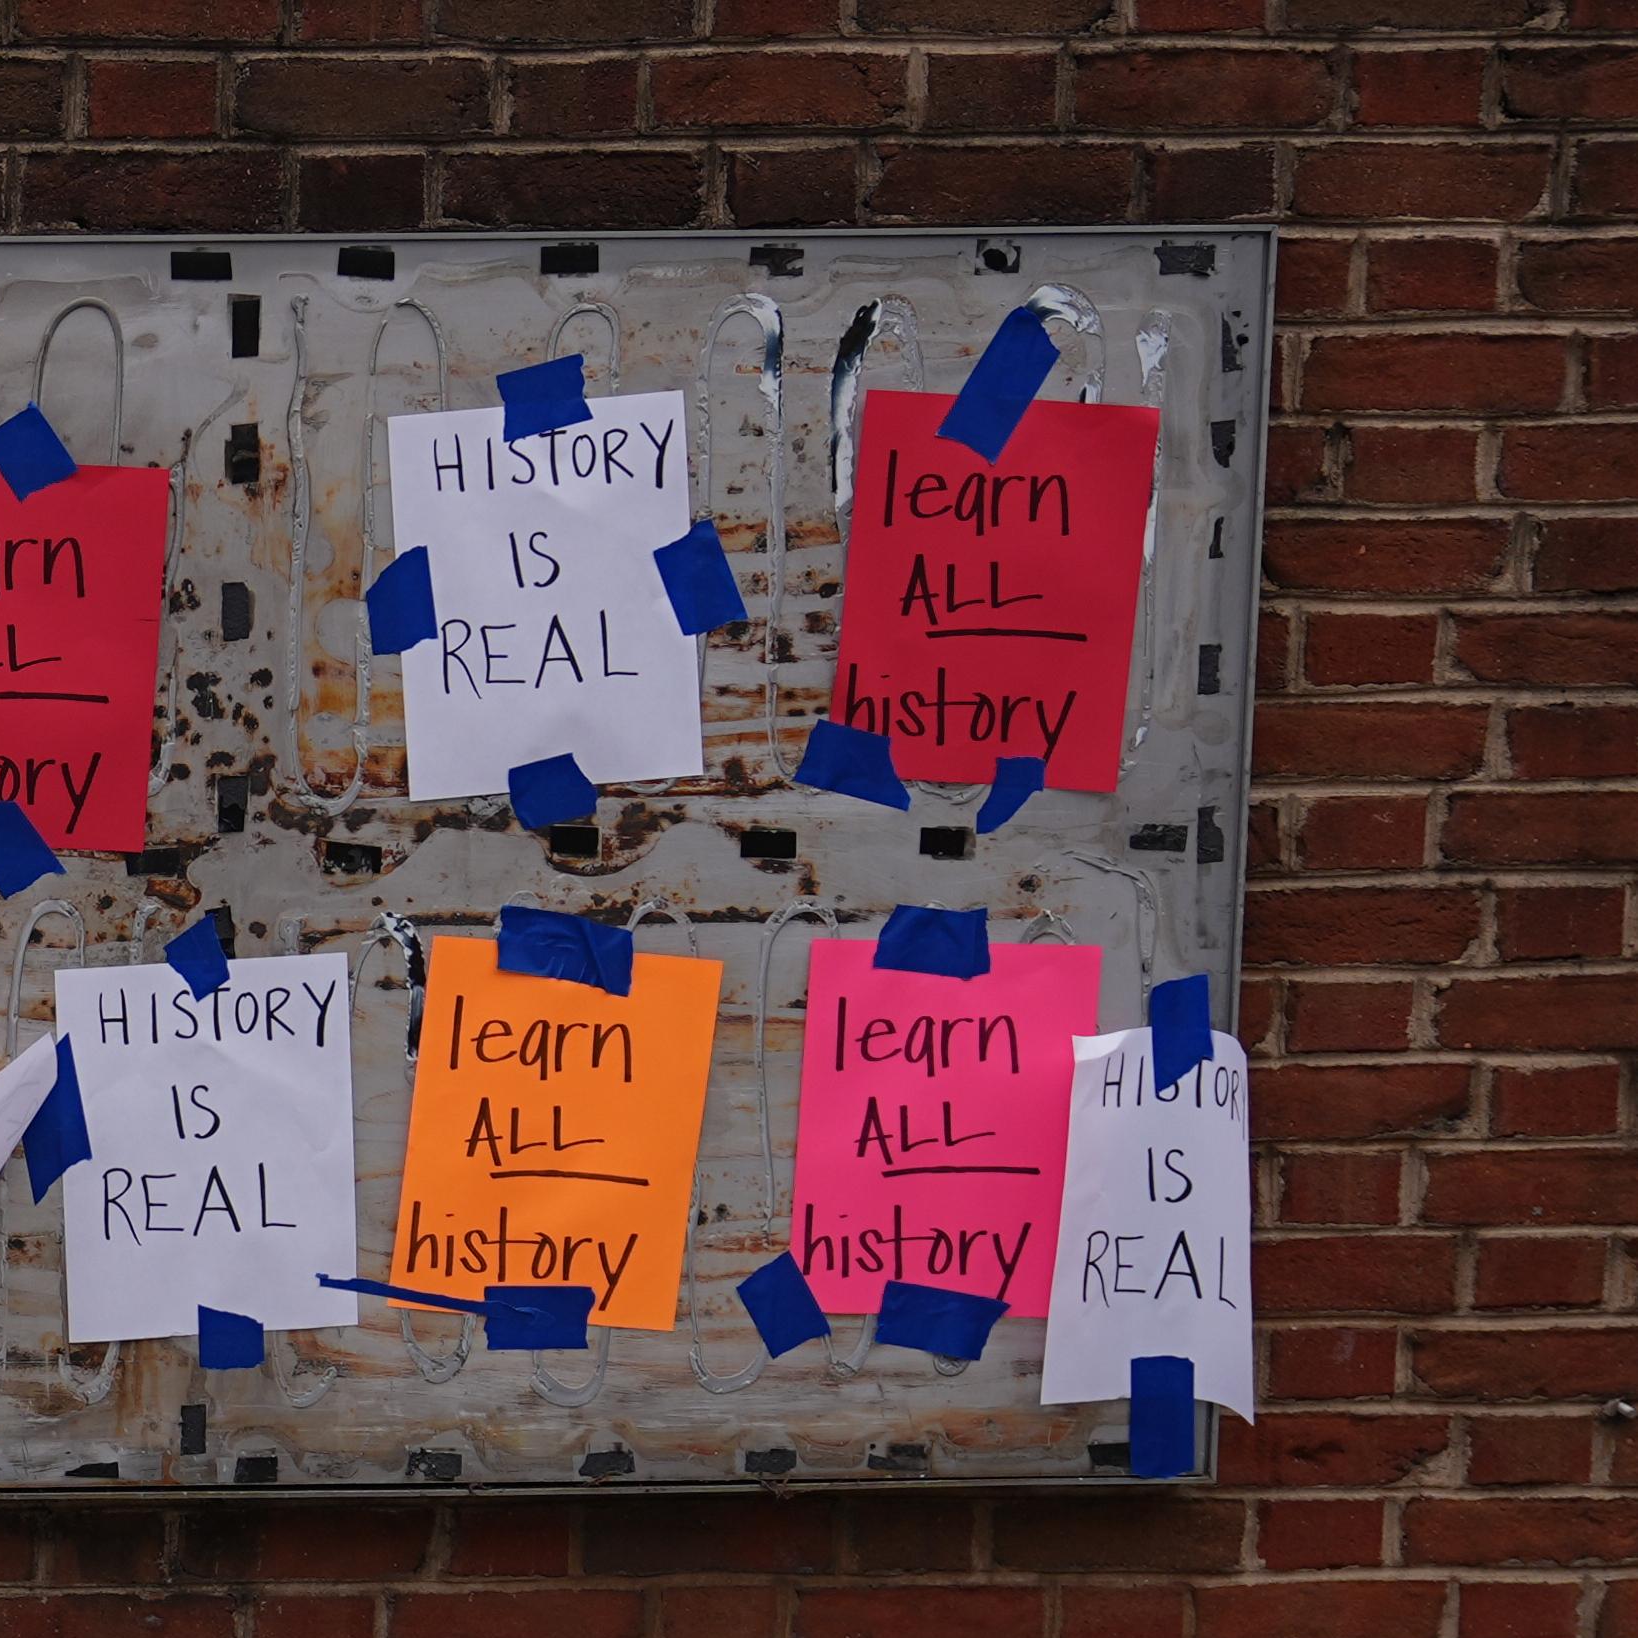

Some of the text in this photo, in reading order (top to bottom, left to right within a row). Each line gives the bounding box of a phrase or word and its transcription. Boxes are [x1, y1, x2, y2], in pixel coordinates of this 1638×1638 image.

[434, 419, 675, 492] HISTORY
[884, 450, 1071, 536] learn
[511, 531, 560, 588] IS
[900, 554, 1044, 625] ALL
[442, 610, 638, 699] REAL
[845, 663, 1076, 760] history
[98, 980, 336, 1048] HISTORY
[450, 995, 632, 1082] learn
[835, 996, 1019, 1077] learn
[173, 1085, 220, 1140] IS
[465, 1097, 605, 1166] ALL
[857, 1096, 996, 1165] ALL
[103, 1163, 297, 1245] REAL
[1149, 1148, 1193, 1203] IS
[406, 1201, 638, 1311] history
[802, 1203, 1032, 1300] history
[1082, 1229, 1237, 1310] REAL
